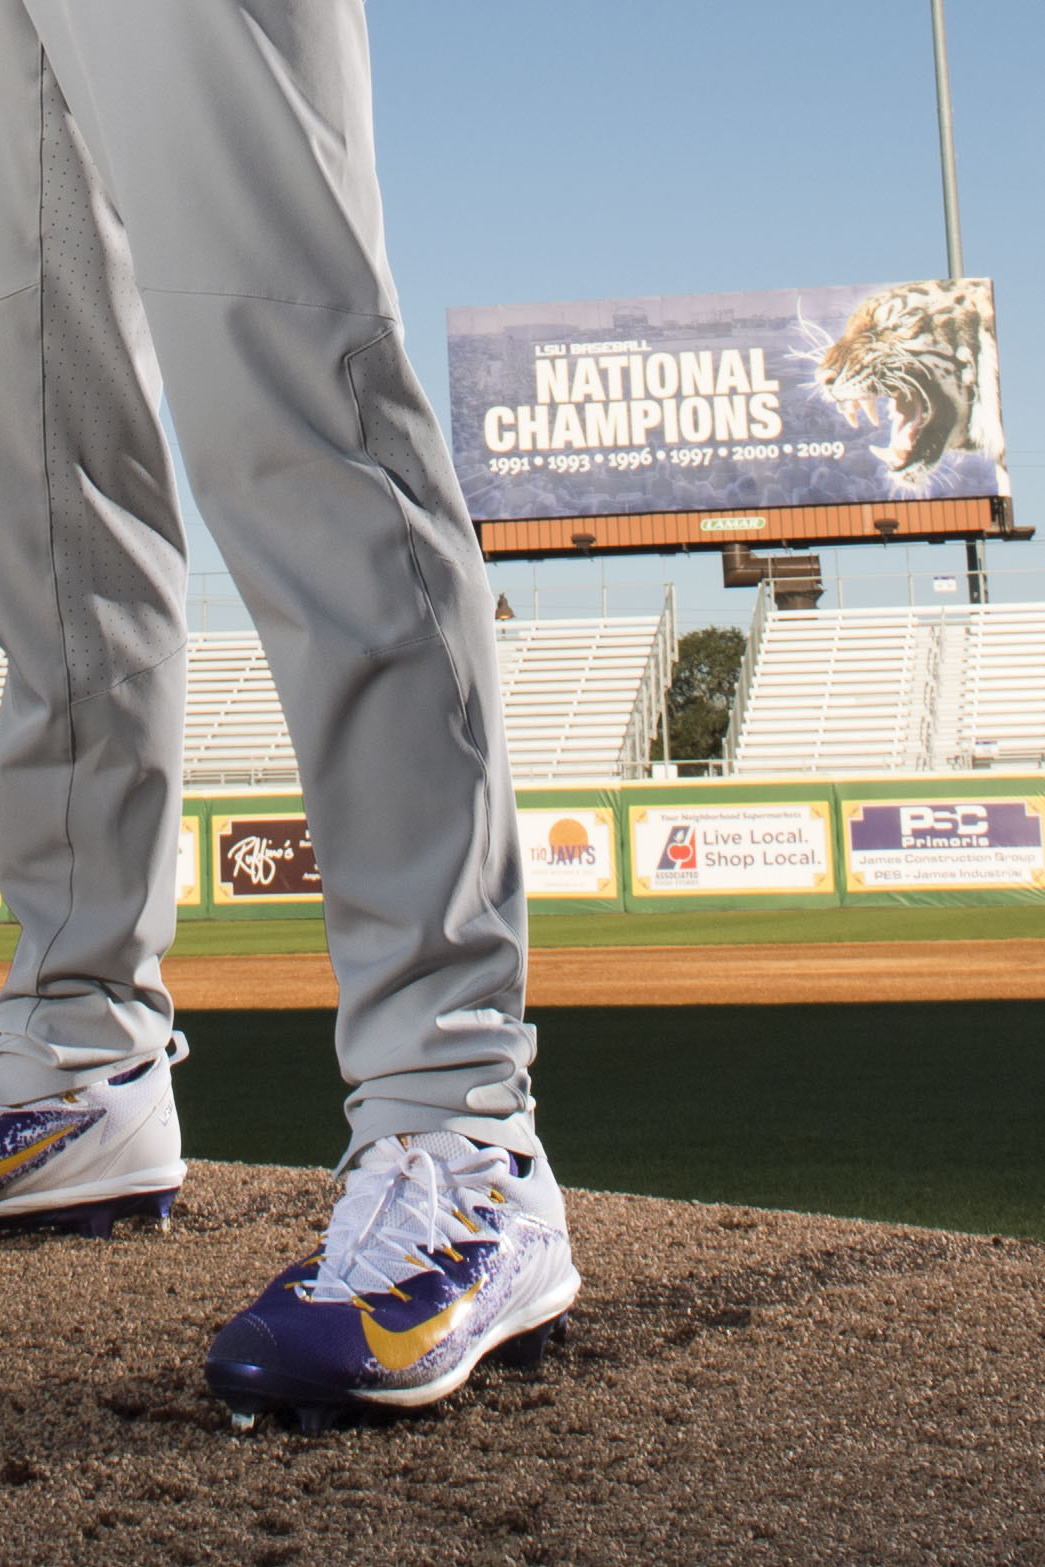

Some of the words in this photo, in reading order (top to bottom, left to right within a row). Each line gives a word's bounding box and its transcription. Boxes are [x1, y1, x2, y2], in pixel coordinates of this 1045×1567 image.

[535, 344, 567, 357] LSU
[570, 340, 652, 355] BASEBALL
[535, 348, 780, 404] NATIONAL
[484, 392, 783, 453] CHAMPIONS
[489, 457, 531, 475] 1991
[547, 454, 591, 473] 1993
[608, 448, 653, 471] 1996
[670, 448, 713, 467] 1997
[732, 445, 779, 460] 2000
[797, 441, 845, 460] 2009
[703, 830, 743, 845] Live
[750, 828, 809, 845] Local.
[901, 835, 990, 848] Primoris
[705, 851, 755, 869] Shop
[763, 849, 822, 866] Local.
[859, 855, 902, 866] James
[905, 852, 992, 864] Construction
[994, 851, 1036, 863] Group
[655, 871, 699, 880] ASSOCIATED
[914, 869, 956, 880] James
[959, 867, 1022, 879] Industrial
